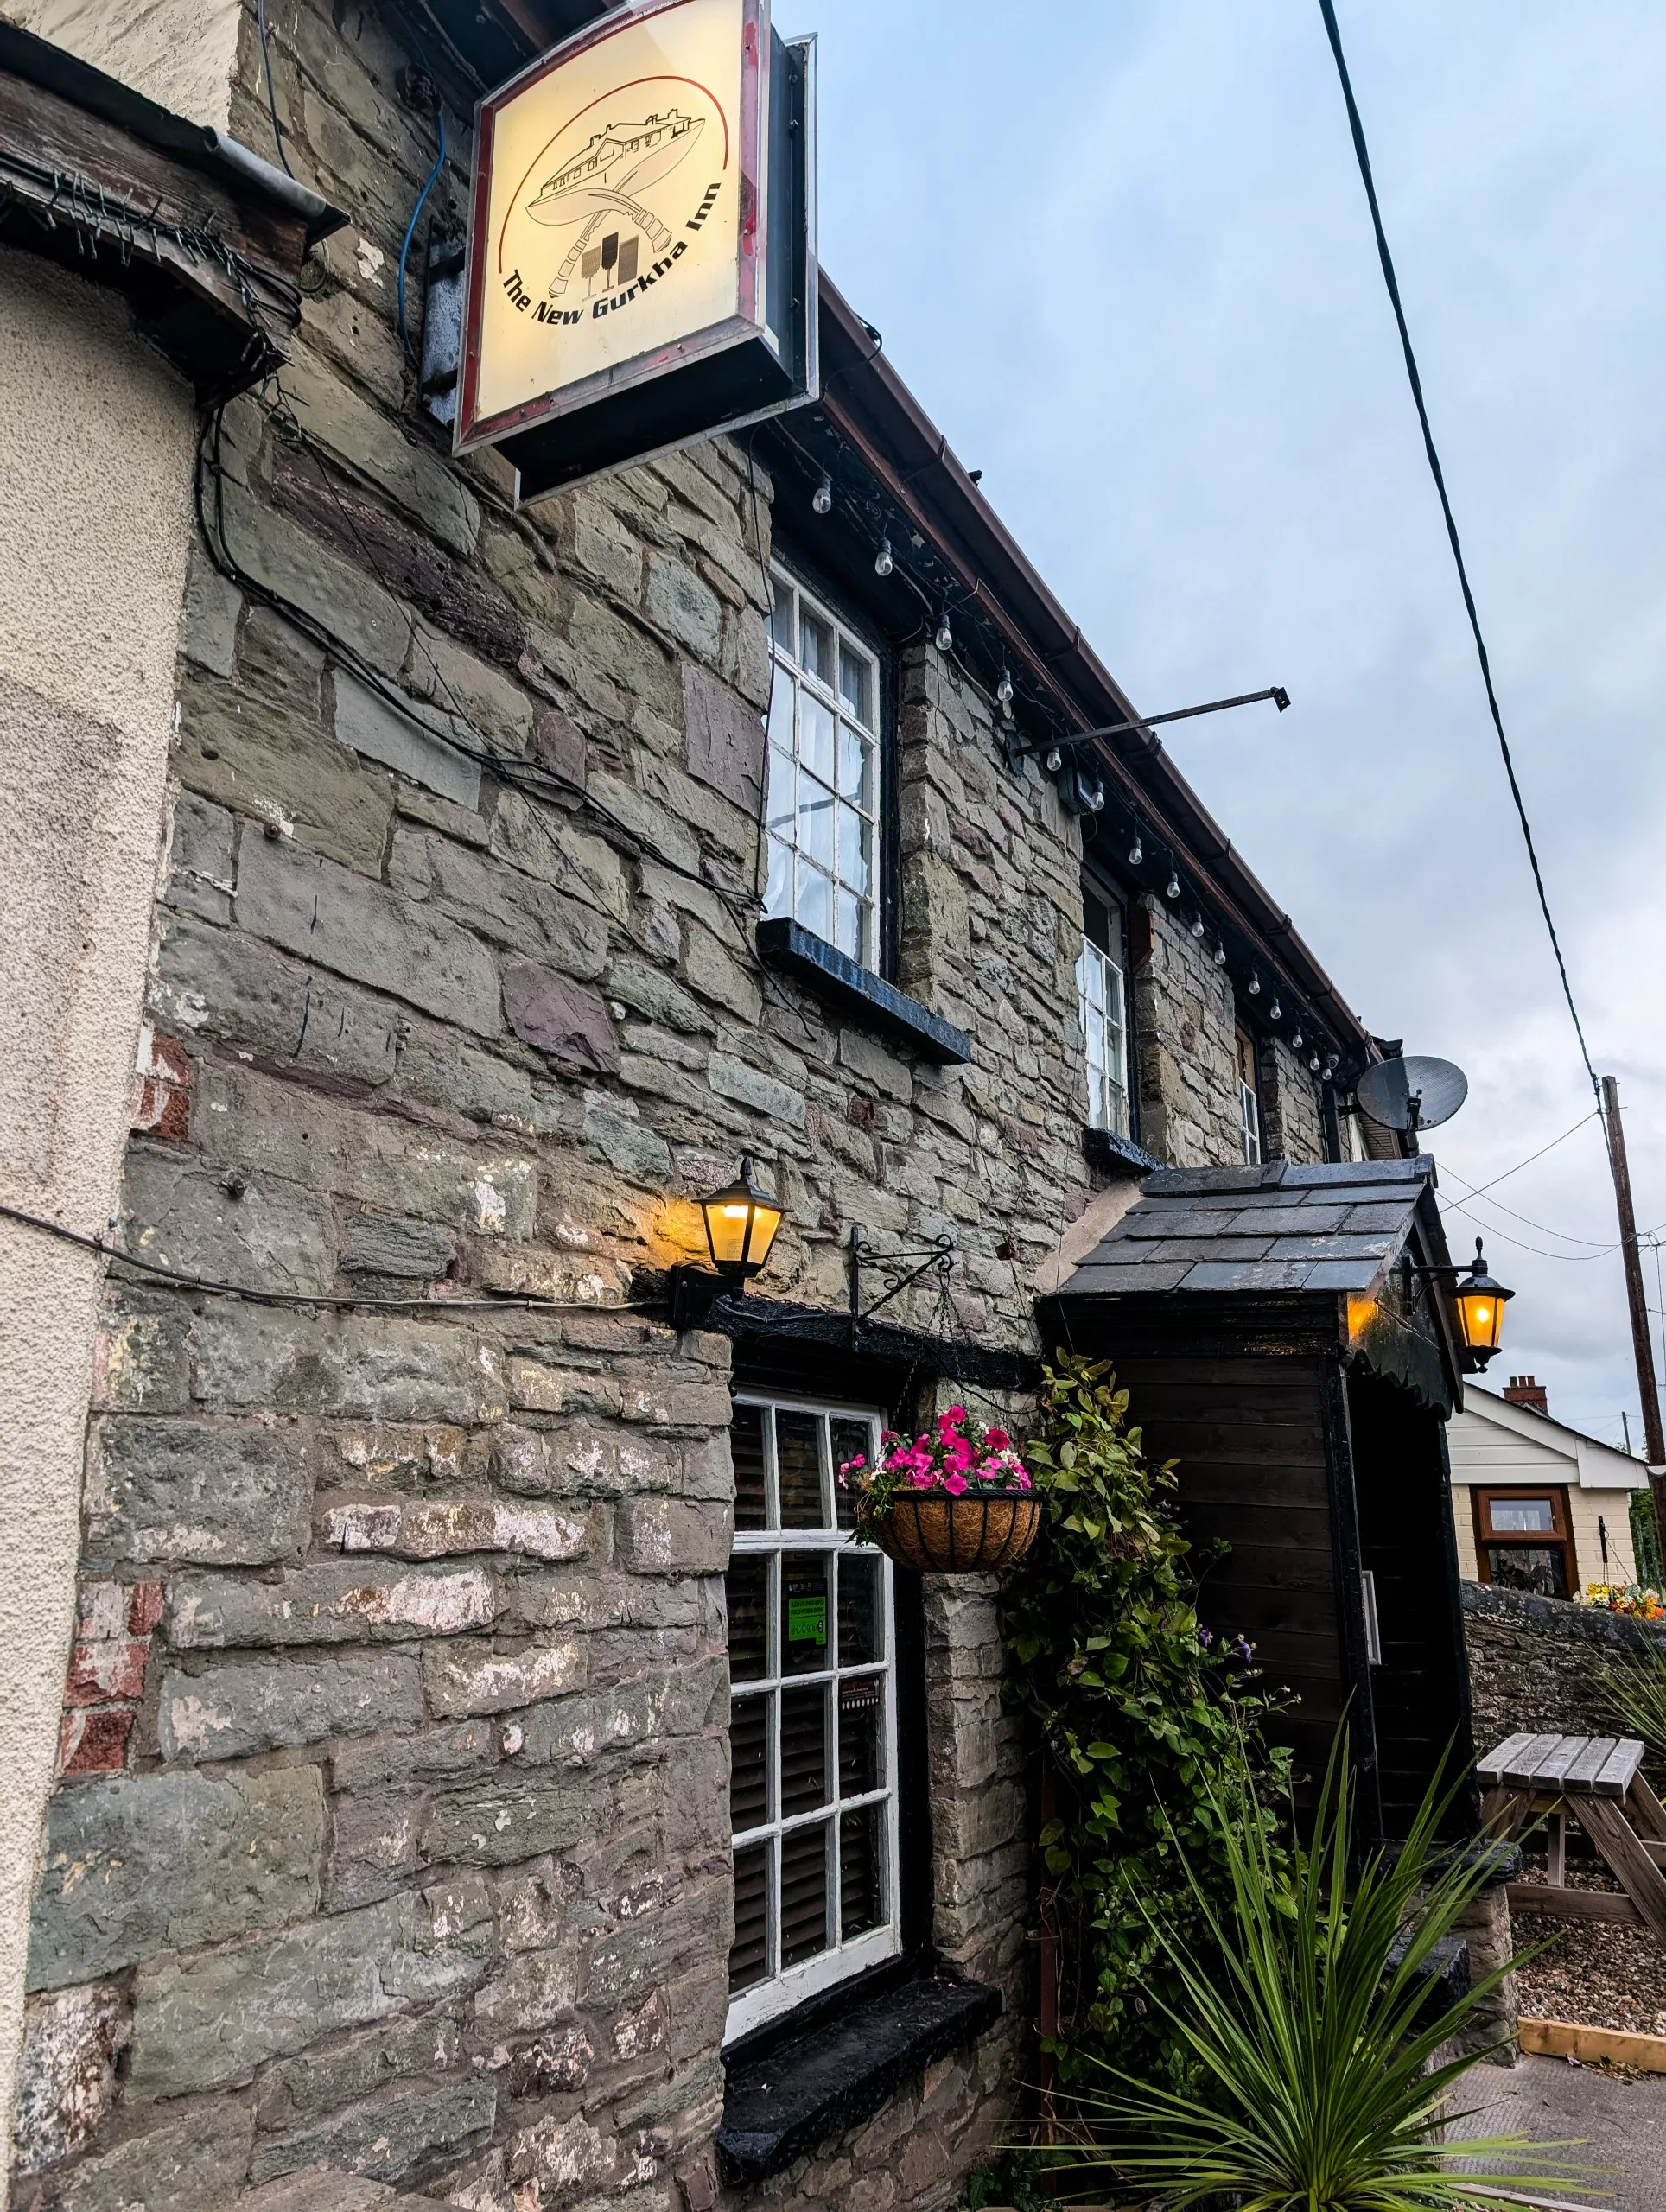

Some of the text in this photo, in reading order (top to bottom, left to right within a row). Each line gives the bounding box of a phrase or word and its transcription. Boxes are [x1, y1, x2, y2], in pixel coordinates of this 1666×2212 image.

[503, 182, 722, 325] The New Gurkha Inn
